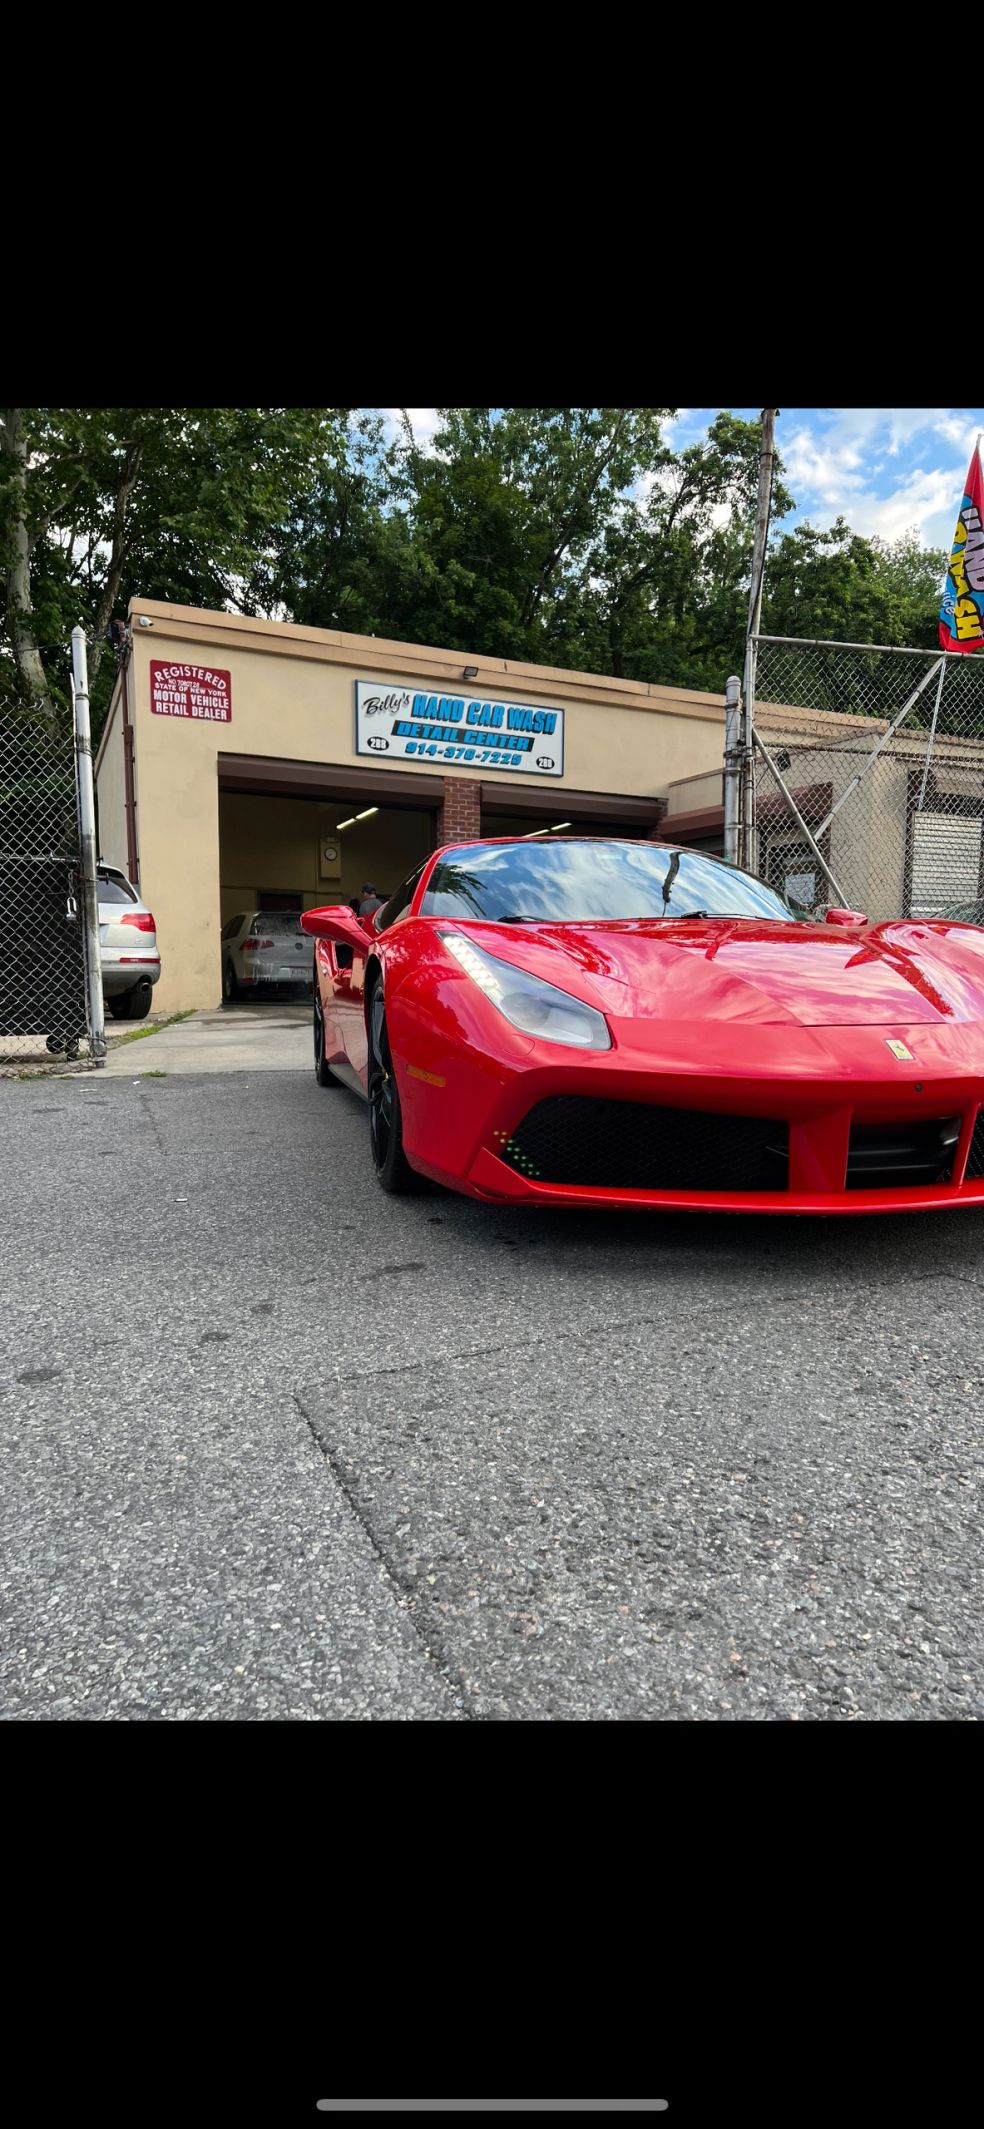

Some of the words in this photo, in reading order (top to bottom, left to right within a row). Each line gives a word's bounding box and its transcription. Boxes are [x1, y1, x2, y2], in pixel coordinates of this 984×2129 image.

[154, 666, 227, 690] REGISTERED
[153, 689, 187, 704] MOTOR
[190, 694, 229, 709] VEHICLE
[154, 682, 177, 691] STATE
[190, 687, 206, 695] NEW
[208, 689, 227, 697] YORK
[156, 701, 189, 716] RETAIL
[192, 706, 227, 720] DEALER
[363, 692, 411, 715] Billy's
[411, 693, 465, 723] HAND
[466, 701, 506, 729] CAR
[507, 707, 558, 735] WASH
[369, 737, 387, 750] 288
[396, 721, 459, 742] DETAIL
[463, 730, 530, 751] CENTER
[538, 757, 553, 770] 288
